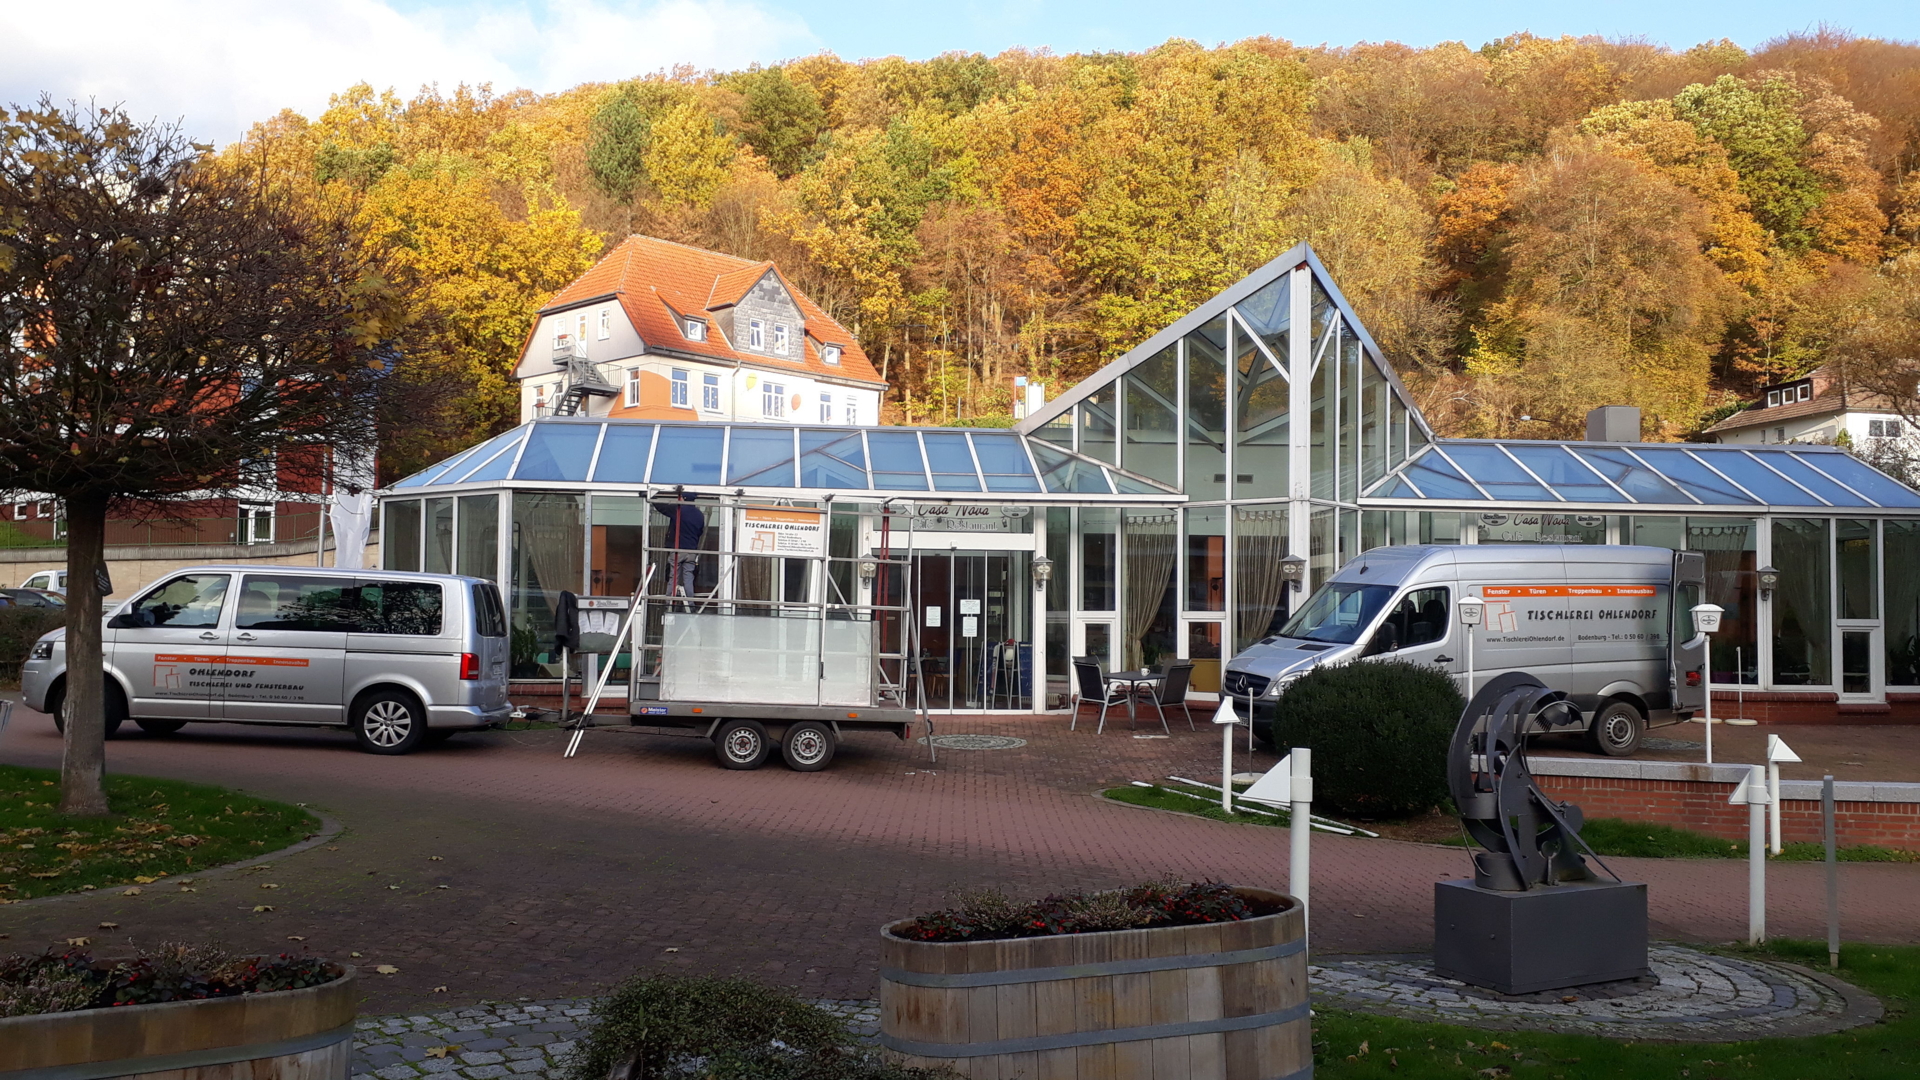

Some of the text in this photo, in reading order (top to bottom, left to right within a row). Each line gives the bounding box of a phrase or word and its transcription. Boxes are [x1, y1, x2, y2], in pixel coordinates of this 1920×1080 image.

[918, 505, 948, 517] Casa
[1513, 514, 1539, 526] Casa
[1568, 588, 1603, 596] Treppenbau
[1527, 609, 1658, 621] TISCHLEREI OHLENDORF
[1486, 635, 1565, 643] www.TischlereiOhlendorf.de
[1578, 634, 1607, 642] Bodenburg
[189, 668, 256, 678] OHLENDORF
[255, 683, 304, 691] FENSTERBAU
